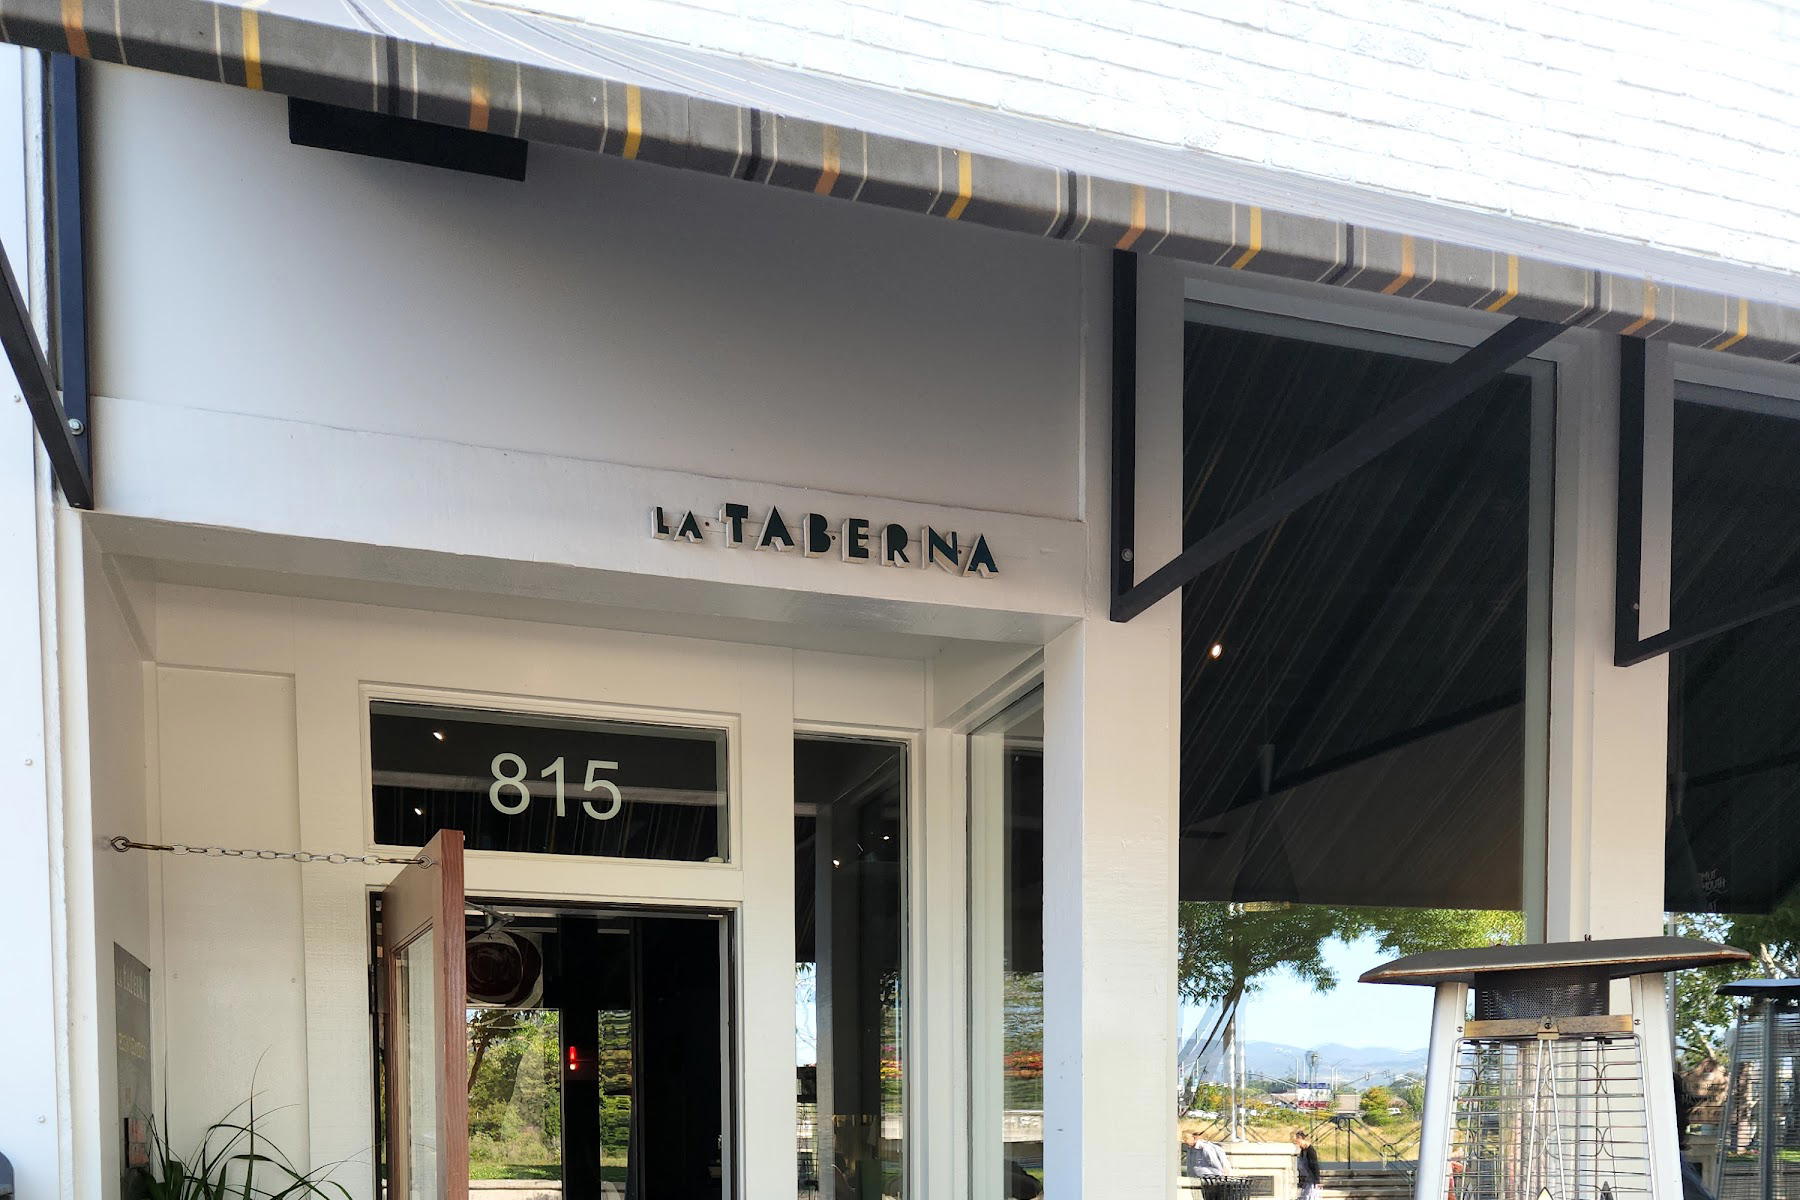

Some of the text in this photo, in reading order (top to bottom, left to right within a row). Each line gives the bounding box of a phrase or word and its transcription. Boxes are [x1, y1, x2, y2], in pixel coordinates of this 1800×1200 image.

[652, 502, 1001, 580] LA TABERNA
[488, 752, 622, 821] 815
